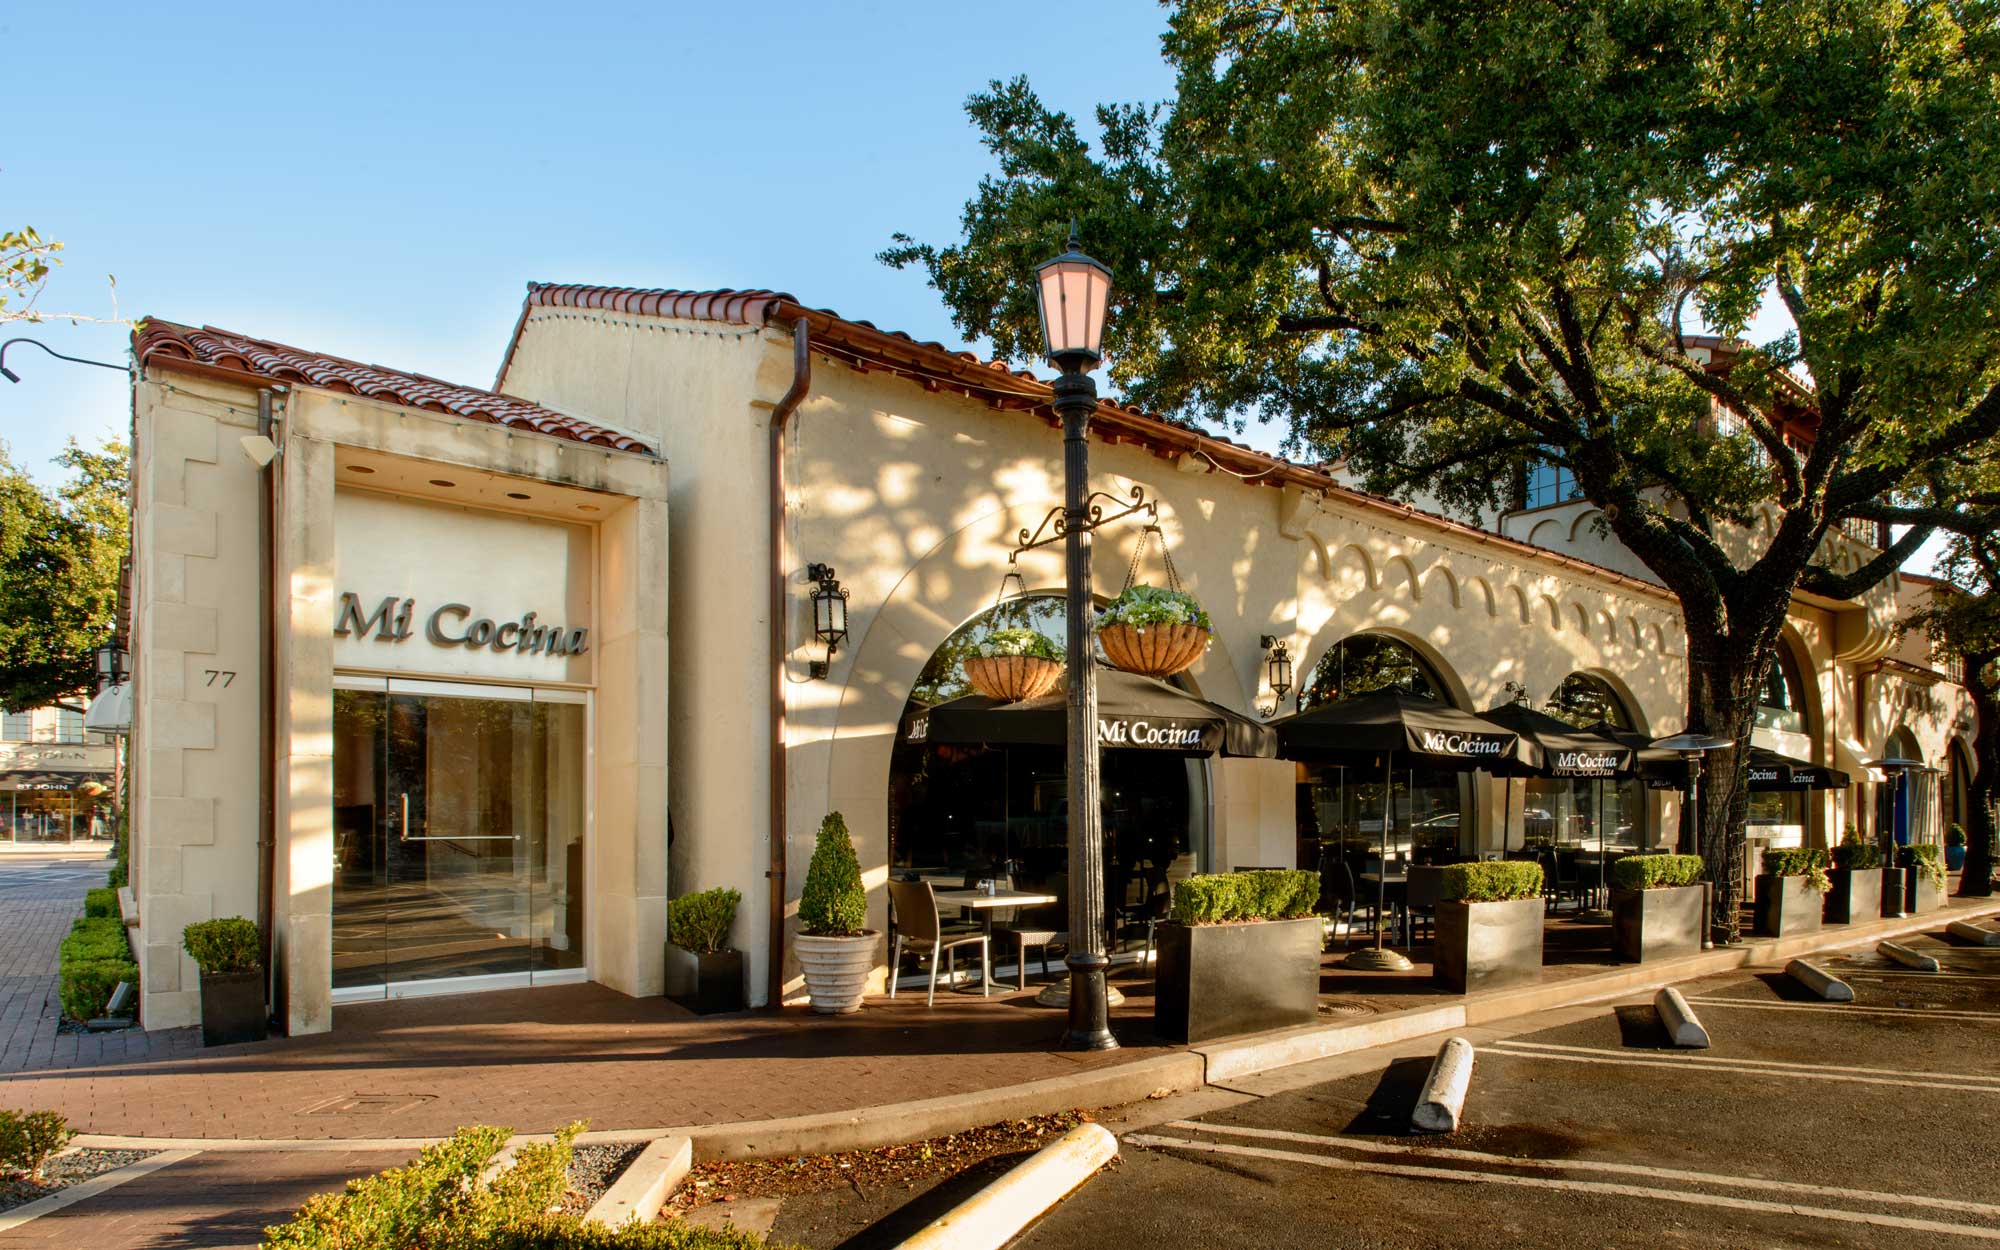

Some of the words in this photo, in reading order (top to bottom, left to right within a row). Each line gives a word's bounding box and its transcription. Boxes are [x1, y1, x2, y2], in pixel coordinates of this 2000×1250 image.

[333, 591, 415, 642] Mi
[425, 602, 589, 656] Cocina
[204, 670, 237, 688] 77
[1097, 719, 1128, 742] Mi
[1131, 721, 1200, 744] Cocina
[1423, 732, 1445, 750] Mi
[1446, 735, 1500, 753] Cocina
[1558, 752, 1577, 767] Mi
[1577, 752, 1617, 768] Cocina
